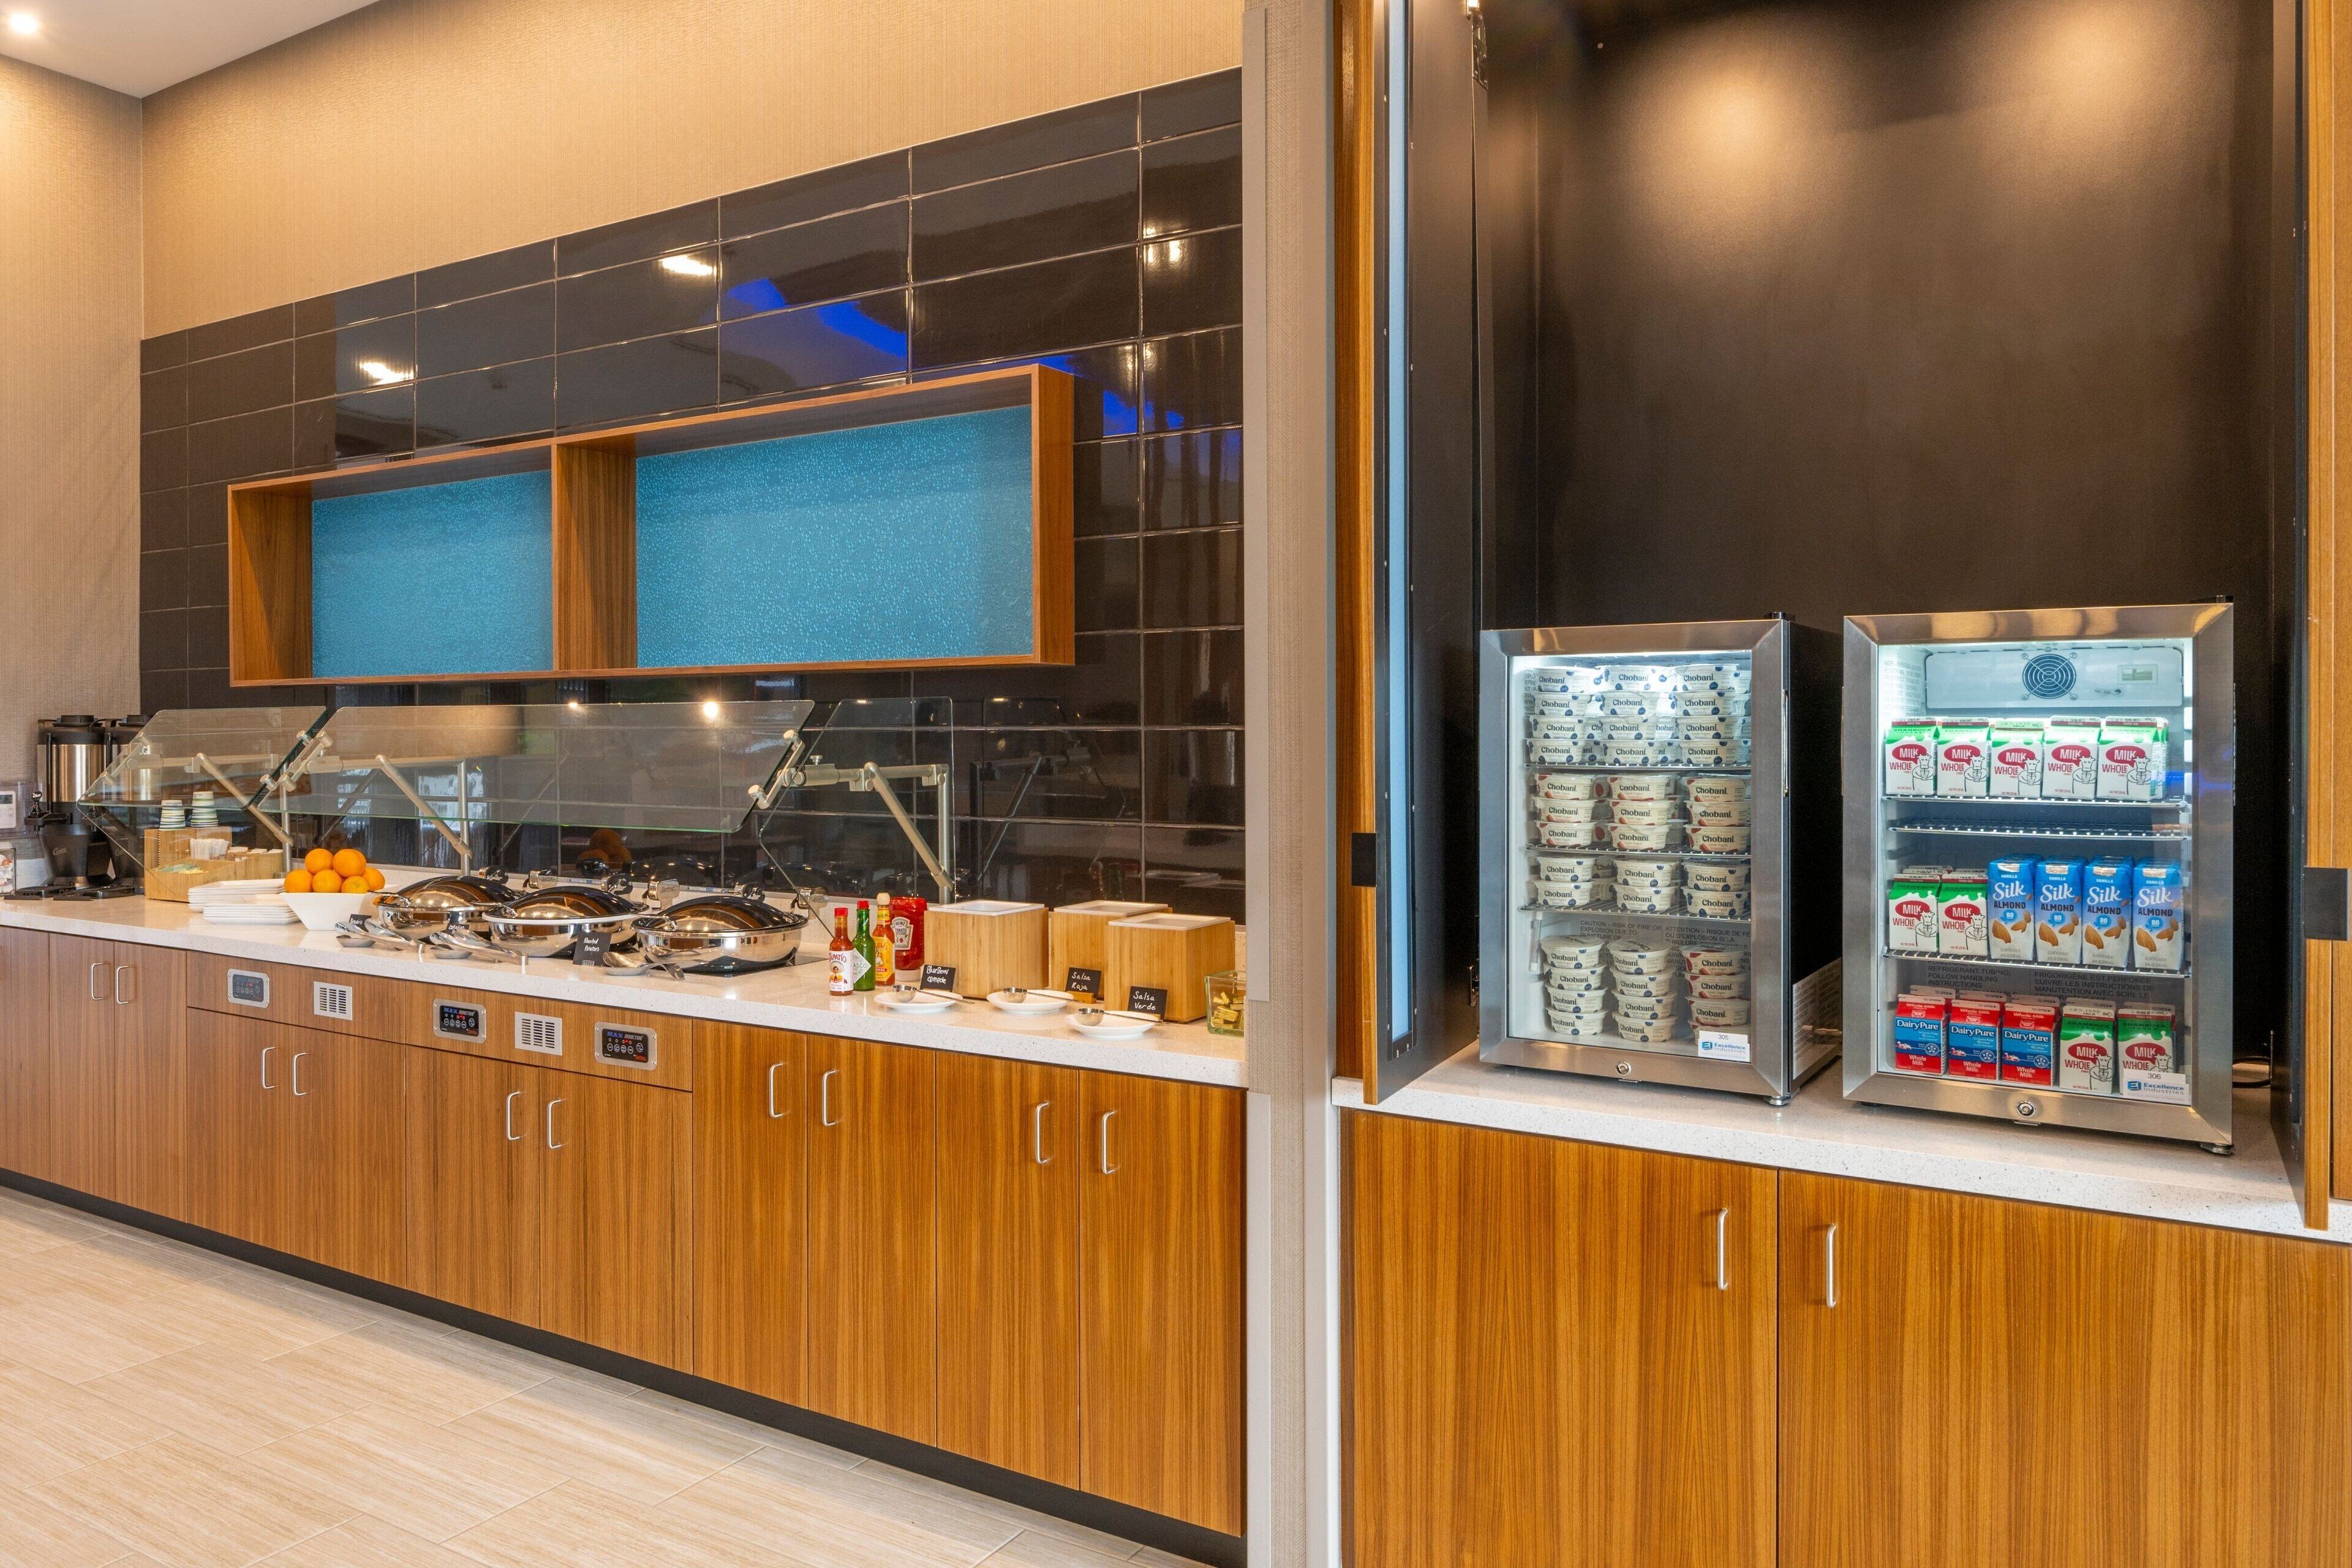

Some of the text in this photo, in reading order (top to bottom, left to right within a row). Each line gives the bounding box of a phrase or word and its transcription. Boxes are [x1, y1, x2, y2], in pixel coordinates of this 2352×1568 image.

[1900, 748, 1918, 758] MILK
[1952, 749, 1971, 759] MILK
[2060, 749, 2081, 759] MILK
[2114, 750, 2136, 760] MILK
[2006, 753, 2026, 763] MILK
[1995, 766, 2018, 775] WHOLE
[2048, 763, 2073, 772] WHOLE
[2102, 764, 2127, 773] WHOLE
[1625, 870, 1654, 878] Chobani
[1992, 881, 2027, 900] Silk
[2040, 883, 2075, 903] Silk
[2087, 886, 2122, 905] Silk
[2137, 888, 2174, 907] Silk
[1902, 905, 1921, 914] MILK
[1953, 908, 1971, 918] MILK
[2138, 908, 2173, 916] ALMOND
[1893, 918, 1915, 927] WHOLE
[1942, 921, 1965, 930] WHOLE
[1615, 957, 1638, 966] Chobani
[1072, 972, 1091, 981] Salsa
[1072, 982, 1088, 990] Roja
[1133, 991, 1155, 1001] Salsa
[1553, 996, 1577, 1005] Chobani
[1135, 1002, 1156, 1011] Verde
[1697, 1009, 1725, 1017] Chobani
[1552, 1018, 1575, 1027] Chobani
[1897, 1020, 1939, 1030] DairyPure
[1620, 1024, 1645, 1033] Chobani
[1951, 1026, 1994, 1036] DairyPure
[2005, 1031, 2048, 1041] DairyPure
[2076, 1047, 2098, 1058] MILK
[2134, 1047, 2156, 1058] MILK
[2065, 1060, 2090, 1069] WHOLE
[2123, 1060, 2149, 1070] WHOLE
